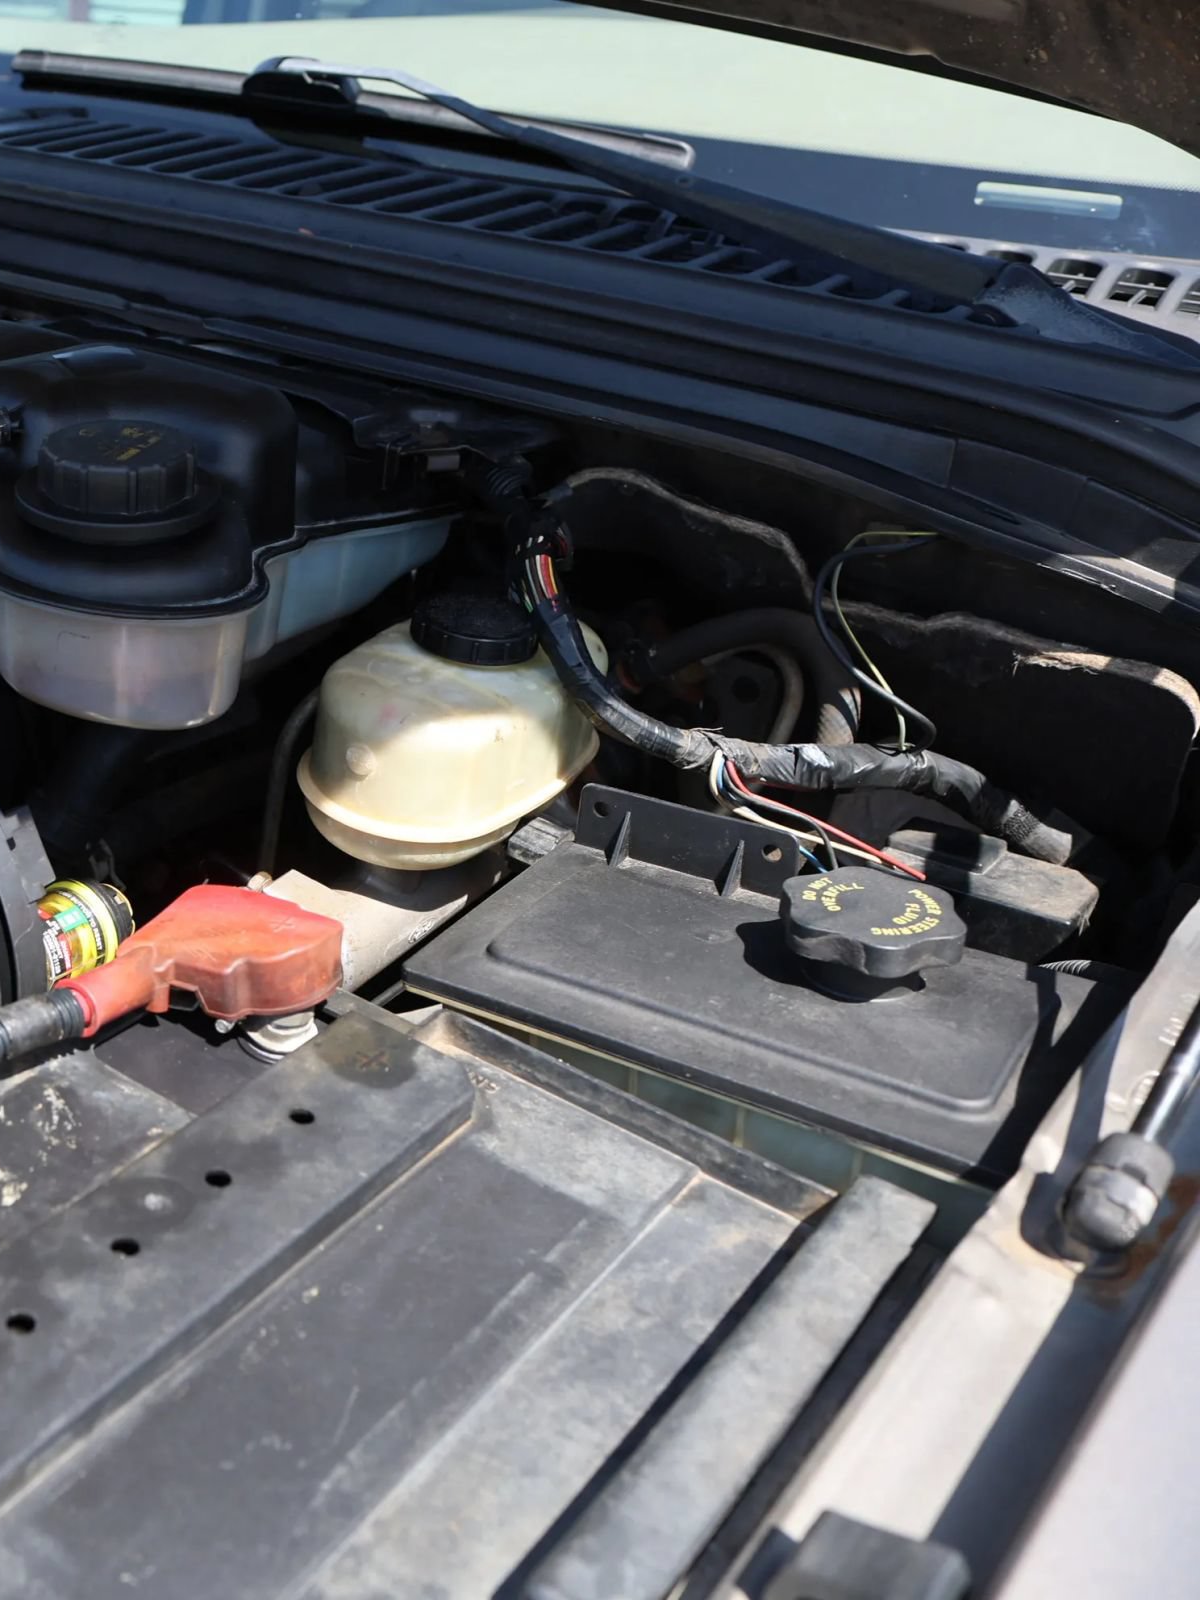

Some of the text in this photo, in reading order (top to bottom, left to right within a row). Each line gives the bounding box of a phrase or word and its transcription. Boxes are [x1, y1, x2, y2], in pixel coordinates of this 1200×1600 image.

[802, 876, 833, 901] DO NOT
[821, 882, 865, 912] OVERFILL
[870, 889, 943, 936] POWER STEERING
[892, 903, 921, 925] FLUID
